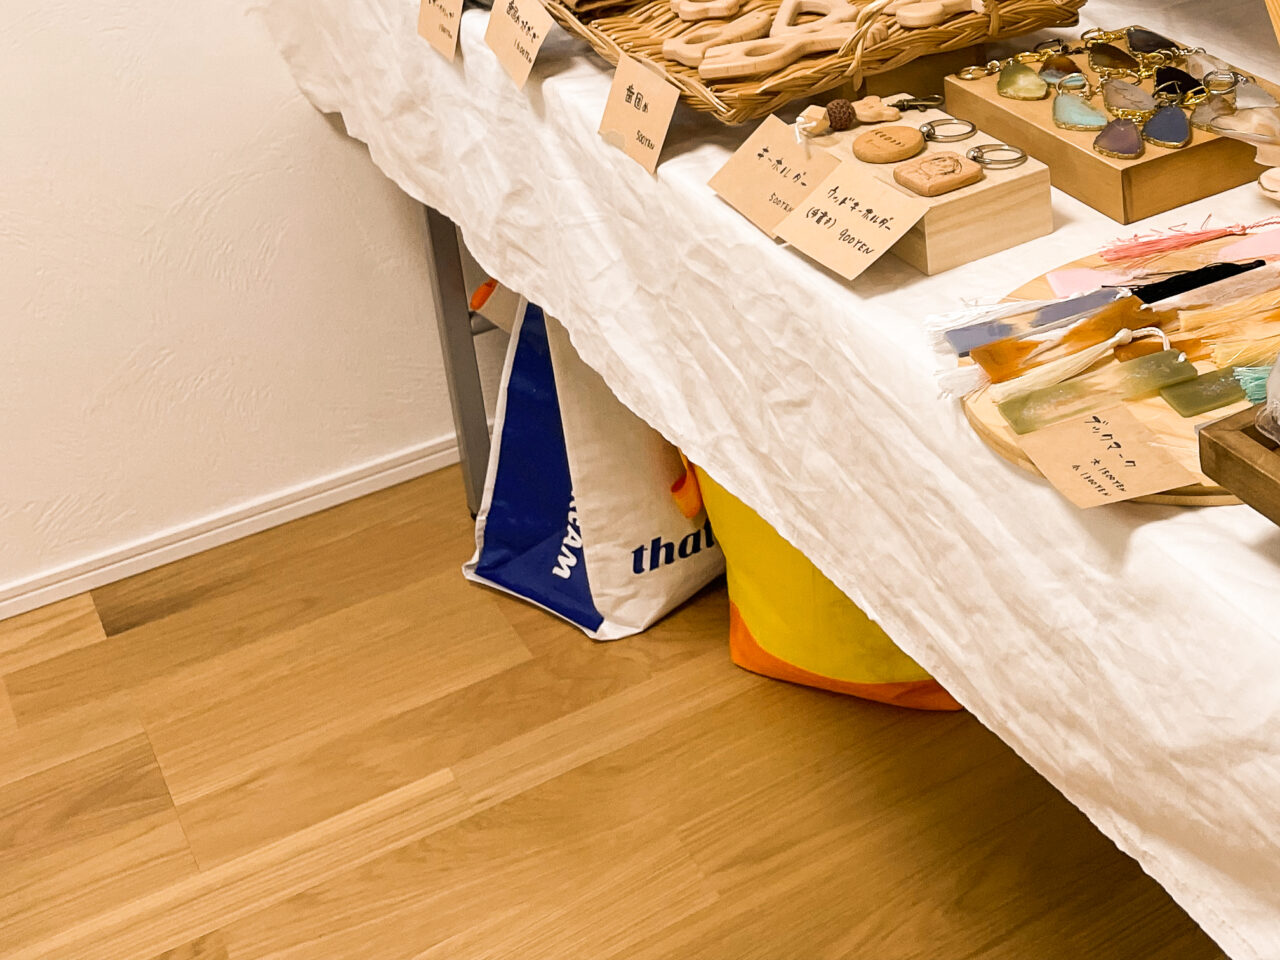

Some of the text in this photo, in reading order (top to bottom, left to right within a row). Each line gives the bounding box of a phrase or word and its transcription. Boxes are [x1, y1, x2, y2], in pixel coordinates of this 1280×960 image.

[757, 146, 808, 187] キーホルダー
[827, 185, 895, 231] ウッドキーホルダー
[838, 228, 875, 255] 900YEN
[1084, 415, 1136, 467] ブックマーク
